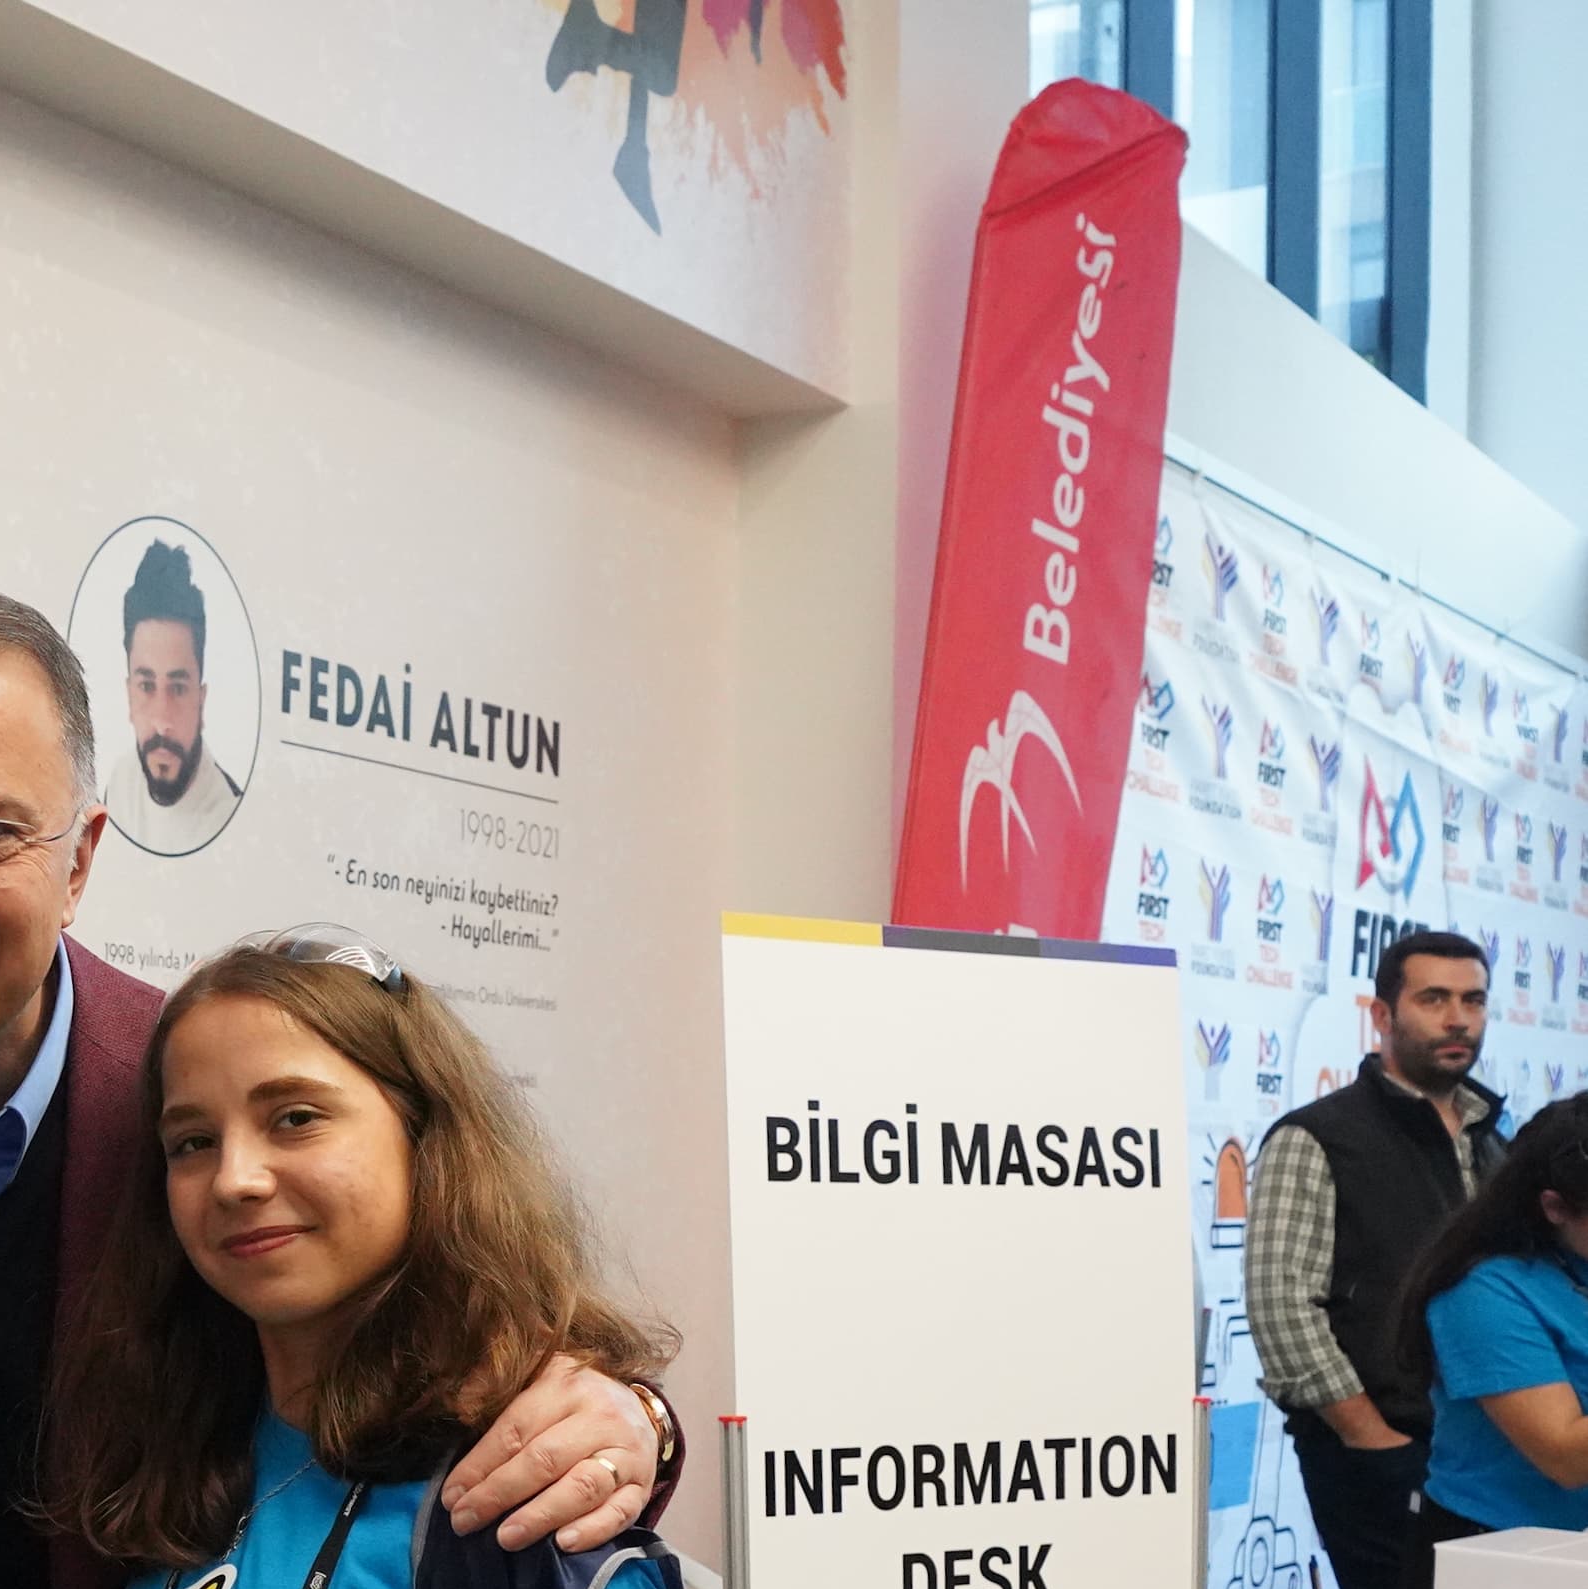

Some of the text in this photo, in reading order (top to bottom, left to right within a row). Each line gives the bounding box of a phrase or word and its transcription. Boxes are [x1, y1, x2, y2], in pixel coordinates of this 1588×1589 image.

[1024, 211, 1117, 665] Belediyesi
[280, 649, 562, 778] FEDAİ ALTUN
[1258, 762, 1286, 788] FIRST
[459, 808, 560, 859] 1998-2021
[345, 859, 560, 918] En son neyinizi kaybettiniz?
[1137, 893, 1169, 919] FIRST
[103, 942, 181, 971] 1998 yılında
[1257, 918, 1283, 942] FIRST
[764, 1099, 1162, 1188] BİLGİ MASASI
[764, 1434, 1178, 1517] INFORMATION
